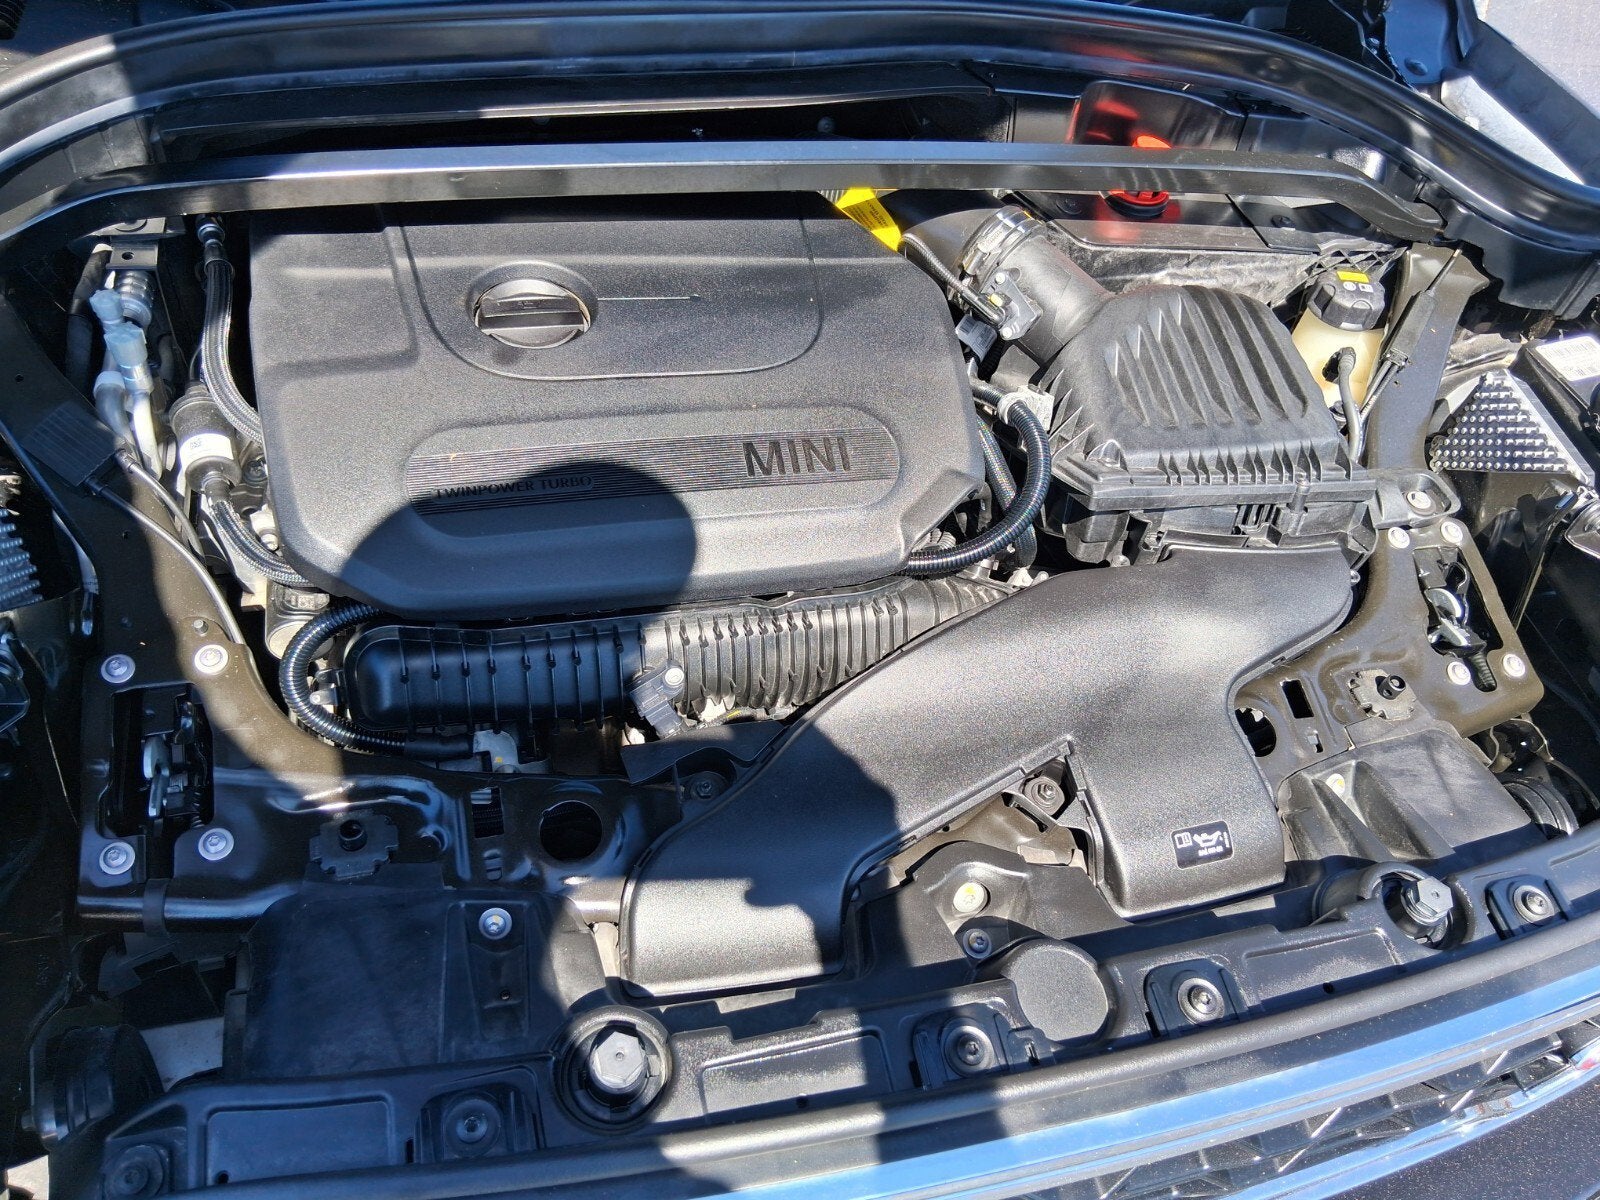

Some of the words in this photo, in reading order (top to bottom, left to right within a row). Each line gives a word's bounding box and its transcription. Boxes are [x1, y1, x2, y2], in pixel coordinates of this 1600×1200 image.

[742, 436, 851, 477] MINI
[433, 479, 534, 499] TWINPOWER
[540, 475, 593, 490] TURBO
